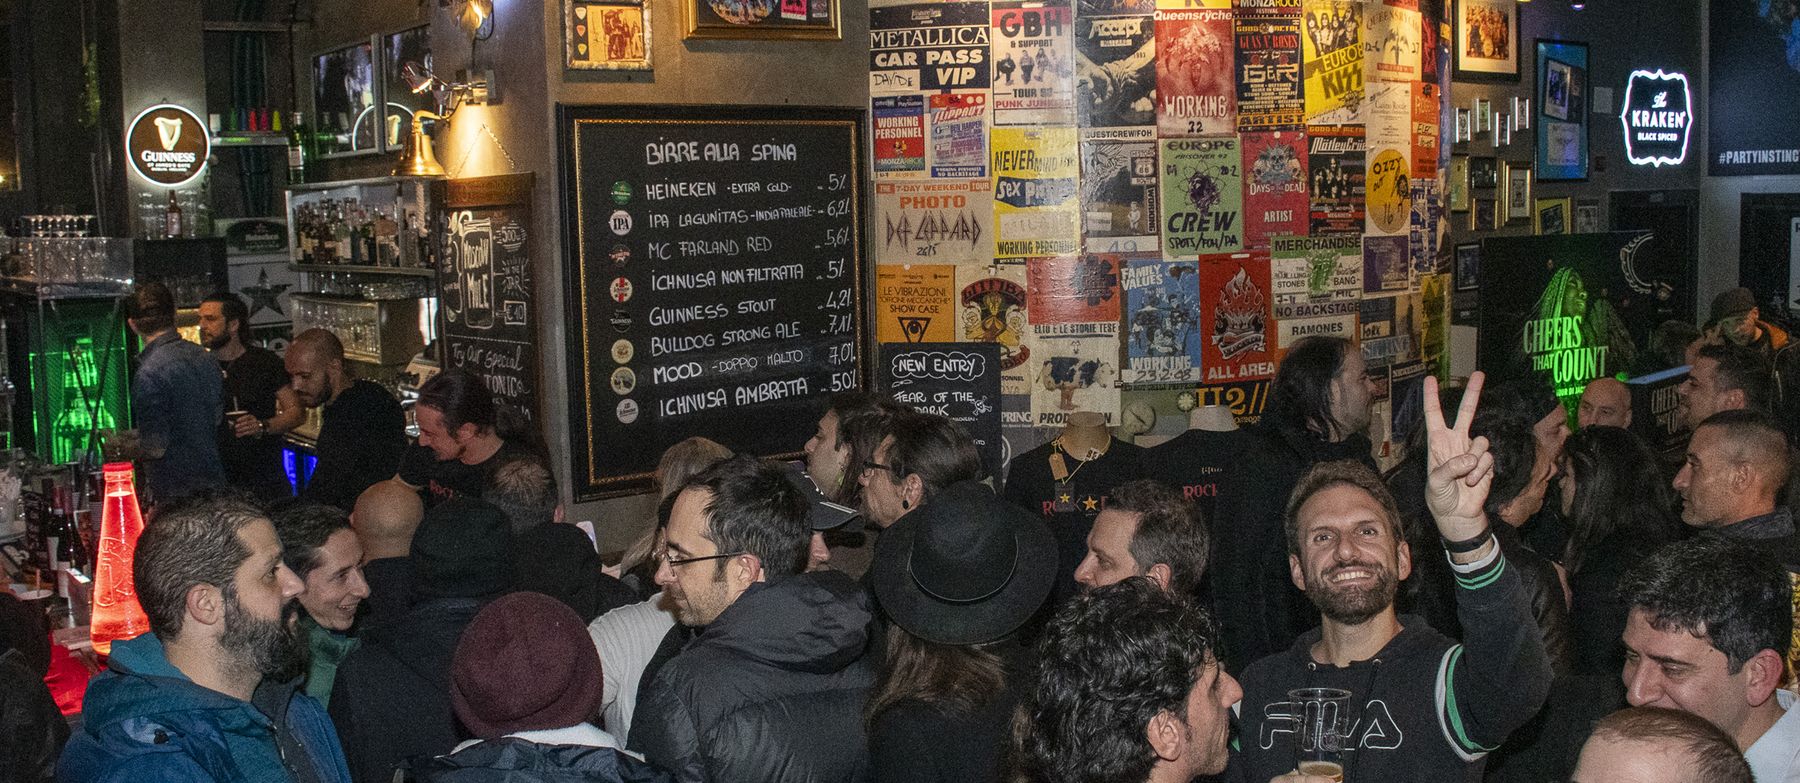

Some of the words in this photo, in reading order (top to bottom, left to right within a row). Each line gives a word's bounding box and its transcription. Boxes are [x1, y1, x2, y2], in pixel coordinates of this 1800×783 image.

[1000, 10, 1062, 38] GBH
[1153, 10, 1232, 22] Queensrÿche
[870, 26, 990, 49] METALLICA
[1019, 39, 1053, 48] SUPPORT
[875, 51, 918, 67] CAR
[926, 49, 983, 65] PASS
[936, 67, 976, 85] VIP
[1013, 88, 1037, 98] TOUR
[1165, 96, 1227, 118] WORKING
[877, 115, 919, 128] WORKING
[1632, 110, 1685, 128] KRAKEN
[875, 127, 922, 139] PERSONNEL
[1638, 132, 1656, 141] BLACK
[1658, 133, 1677, 141] SPICED
[646, 137, 700, 165] BIRRE
[704, 142, 739, 161] ALLA
[751, 138, 797, 160] SPINA
[1166, 140, 1235, 152] EUROPE
[141, 150, 196, 163] GUINNESS
[995, 150, 1034, 172] NEVER
[1719, 150, 1800, 164] #PARTYINSTINC
[1373, 156, 1402, 178] OZZY
[646, 178, 716, 200] HEINEKEN
[923, 183, 968, 191] WEEKEND
[971, 181, 990, 190] TOUR
[1250, 183, 1271, 195] DAYS
[1284, 182, 1305, 193] DEAD
[900, 195, 966, 209] PHOTO
[1148, 188, 1156, 232] WORKING
[613, 217, 630, 230] IPA
[648, 210, 669, 228] IPA
[1168, 212, 1237, 233] CREW
[1264, 210, 1293, 223] ARTIST
[886, 210, 911, 252] DEF
[915, 210, 982, 251] LEPPARD
[648, 242, 671, 260] MC
[678, 239, 739, 257] FARLAND
[747, 236, 772, 252] RED
[997, 241, 1033, 255] WORKING
[1275, 237, 1361, 251] MERCHANDISE
[652, 269, 716, 291] ICHNUSA
[721, 269, 745, 284] NON
[746, 264, 804, 282] FILTRATA
[1121, 264, 1162, 280] FAMILY
[1121, 274, 1163, 291] VALUES
[1277, 280, 1305, 288] STONES
[883, 287, 892, 296] LE
[894, 286, 946, 297] VIBRAZIONI
[649, 303, 729, 326] GUINNESS
[738, 298, 776, 313] STOUT
[890, 304, 916, 313] SHOW
[918, 305, 939, 313] CASE
[1275, 307, 1292, 317] NO
[1296, 302, 1361, 316] BACKSTAGE
[1060, 325, 1067, 333] LE
[1070, 324, 1096, 333] STORIE
[1099, 323, 1116, 332] TESE
[1292, 323, 1343, 336] RAMONES
[1523, 315, 1582, 354] CHEERS
[652, 333, 715, 356] BULLDOG
[721, 327, 770, 345] STRONG
[776, 321, 801, 338] ALE
[653, 362, 702, 384] MOOD
[767, 349, 803, 365] MALTO
[899, 356, 926, 372] NEW
[934, 359, 975, 376] ENTRY
[1130, 356, 1192, 370] WORKING
[1208, 366, 1235, 380] ALL
[1239, 362, 1275, 376] AREA
[1532, 354, 1555, 371] THAT
[1553, 346, 1609, 383] COUNT
[660, 388, 727, 416] ICHNUSA
[735, 377, 808, 406] AMBRATA
[893, 391, 926, 403] FEAR
[933, 392, 948, 402] OF
[952, 392, 975, 401] THE
[914, 404, 949, 416] DARK
[1260, 700, 1403, 752] FILA
